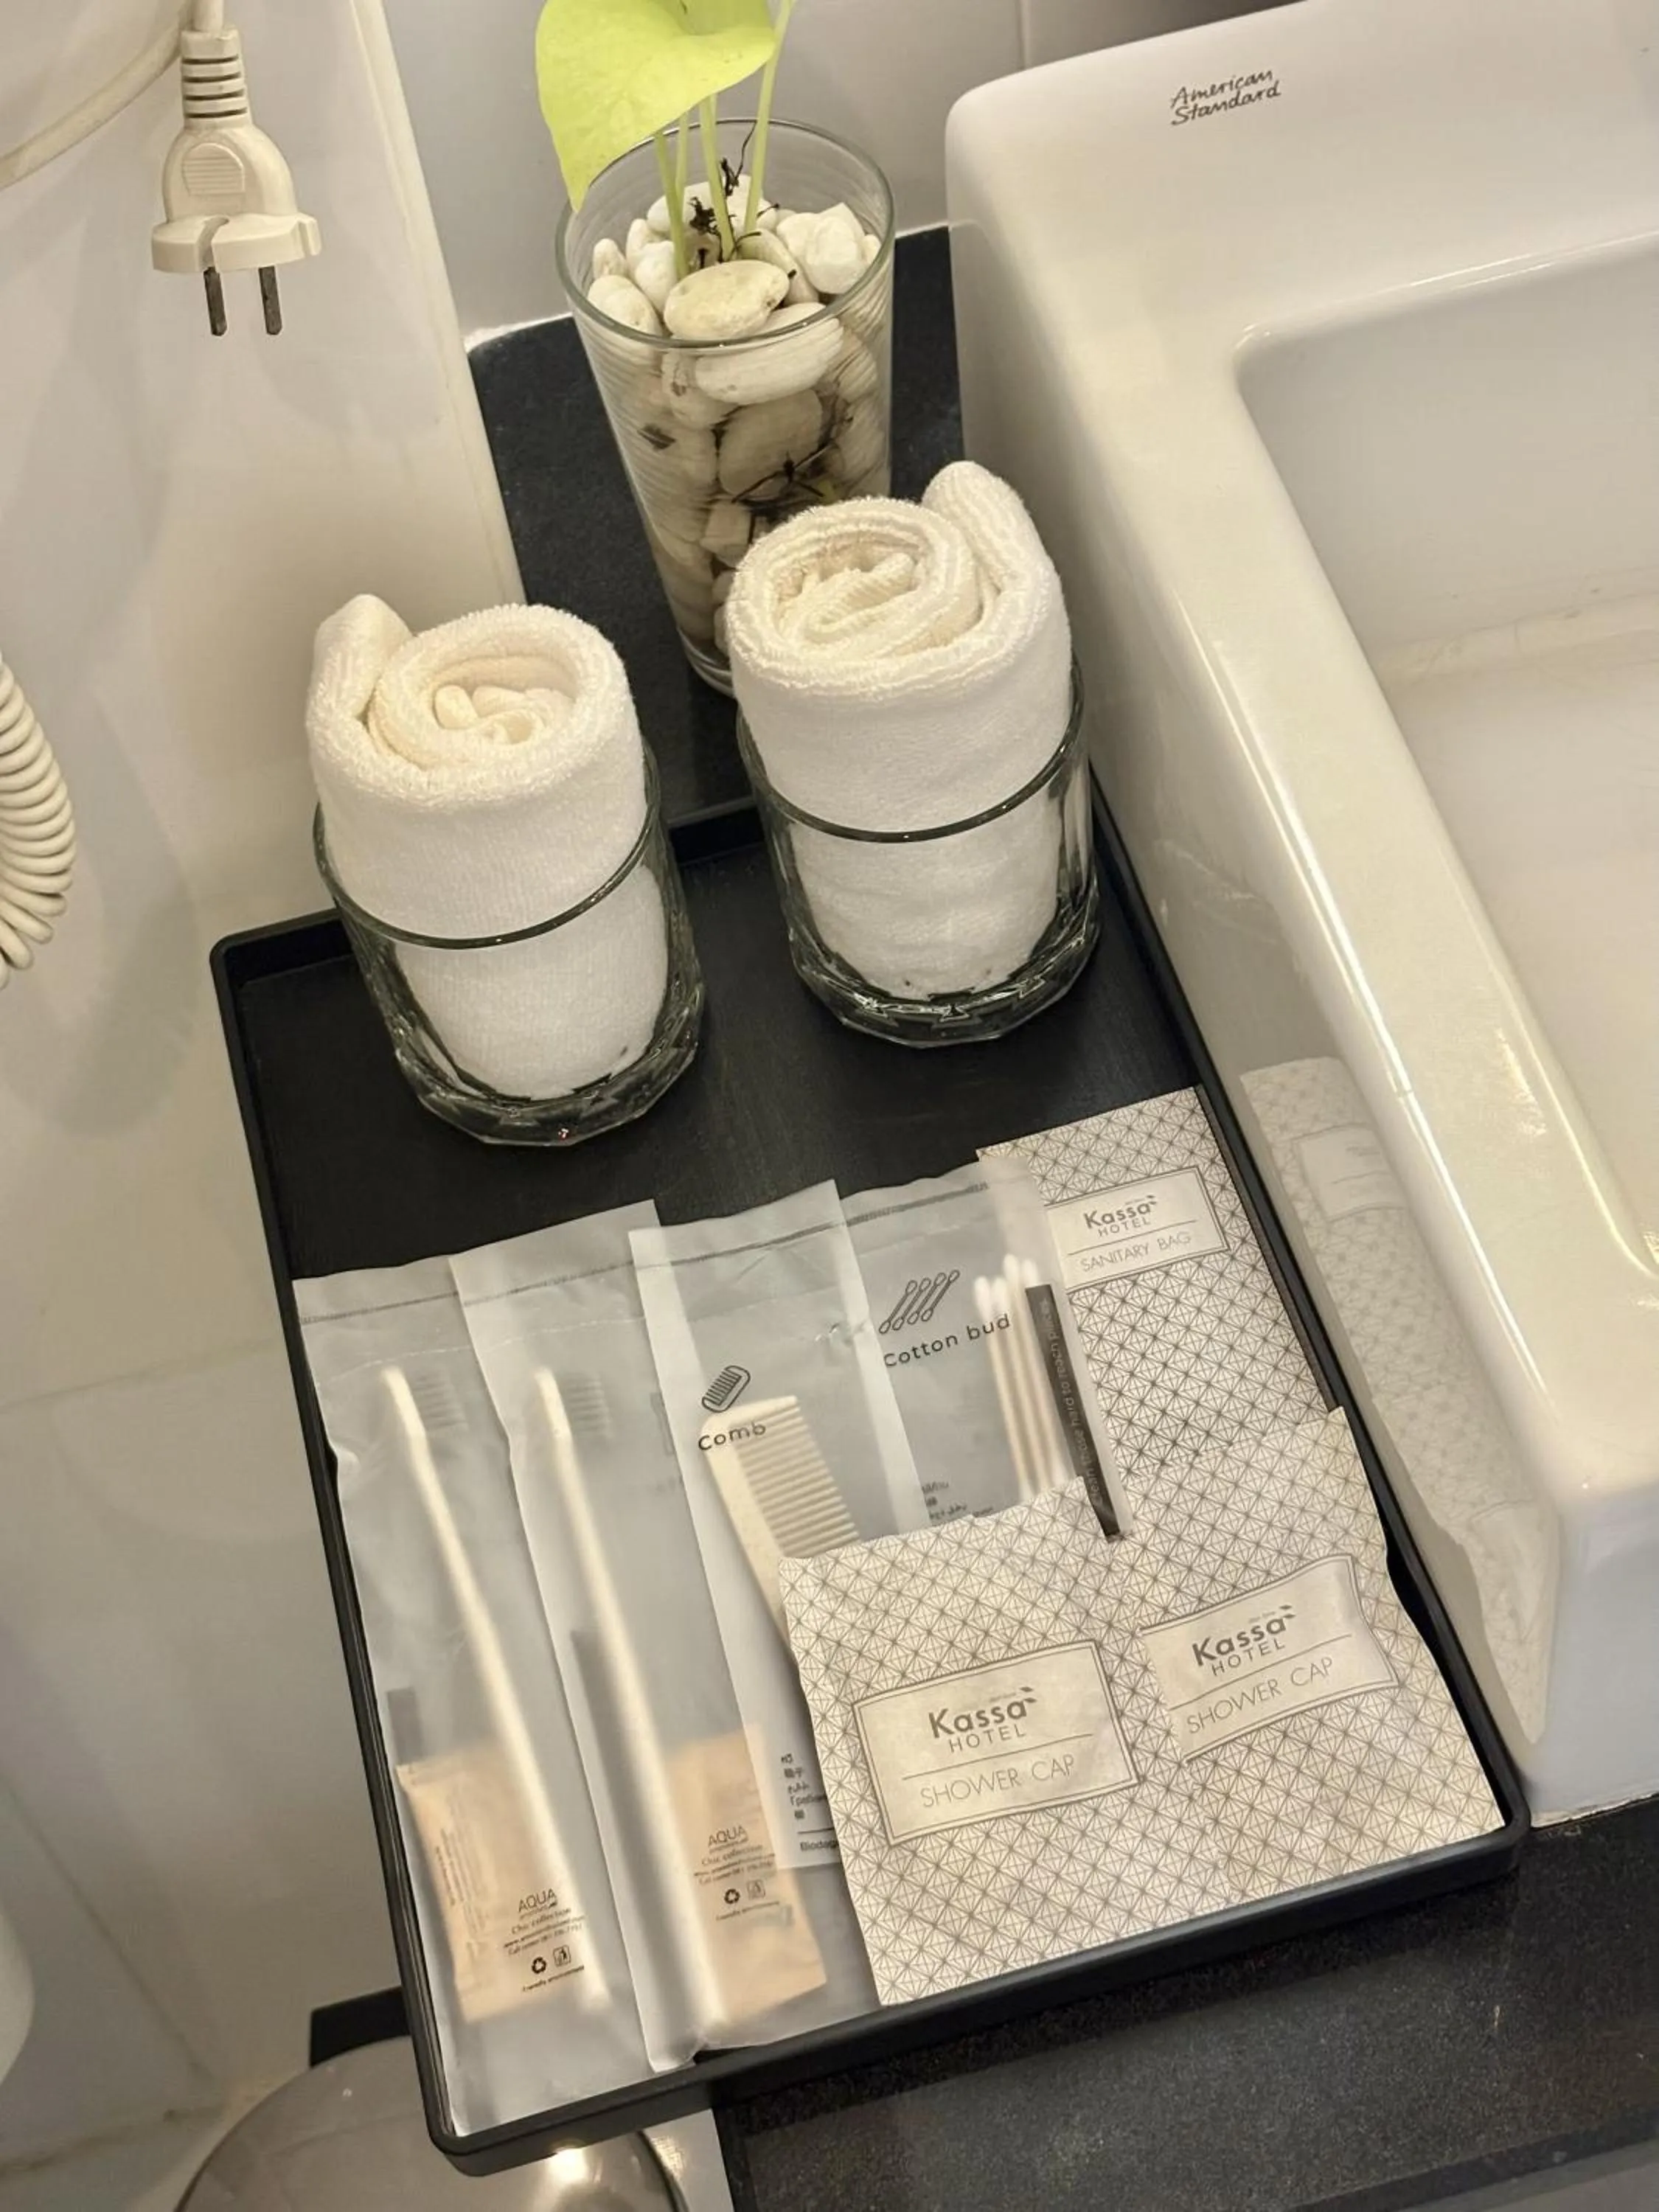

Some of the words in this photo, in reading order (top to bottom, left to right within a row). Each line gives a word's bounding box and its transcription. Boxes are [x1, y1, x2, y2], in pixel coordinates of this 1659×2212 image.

[1170, 70, 1273, 108] American
[1171, 80, 1281, 125] Standard
[1083, 1202, 1152, 1229] Kassa
[1098, 1216, 1151, 1237] HOTEL
[1079, 1242, 1150, 1272] SANITARY
[1157, 1231, 1192, 1251] BAG
[883, 1335, 959, 1367] Cotton
[966, 1313, 1010, 1340] bud
[698, 1422, 766, 1450] Comb
[1192, 1618, 1287, 1666] Kassa
[1211, 1638, 1286, 1677] HOTEL
[1186, 1677, 1283, 1734] SHOWER
[1290, 1656, 1332, 1687] CAP
[928, 1699, 1028, 1739] Kassa
[949, 1724, 1026, 1753] HOTEL
[919, 1768, 1022, 1808] SHOWER
[1031, 1753, 1075, 1782] CAP
[708, 1825, 748, 1847] AQUA
[518, 1888, 557, 1913] AQUA
